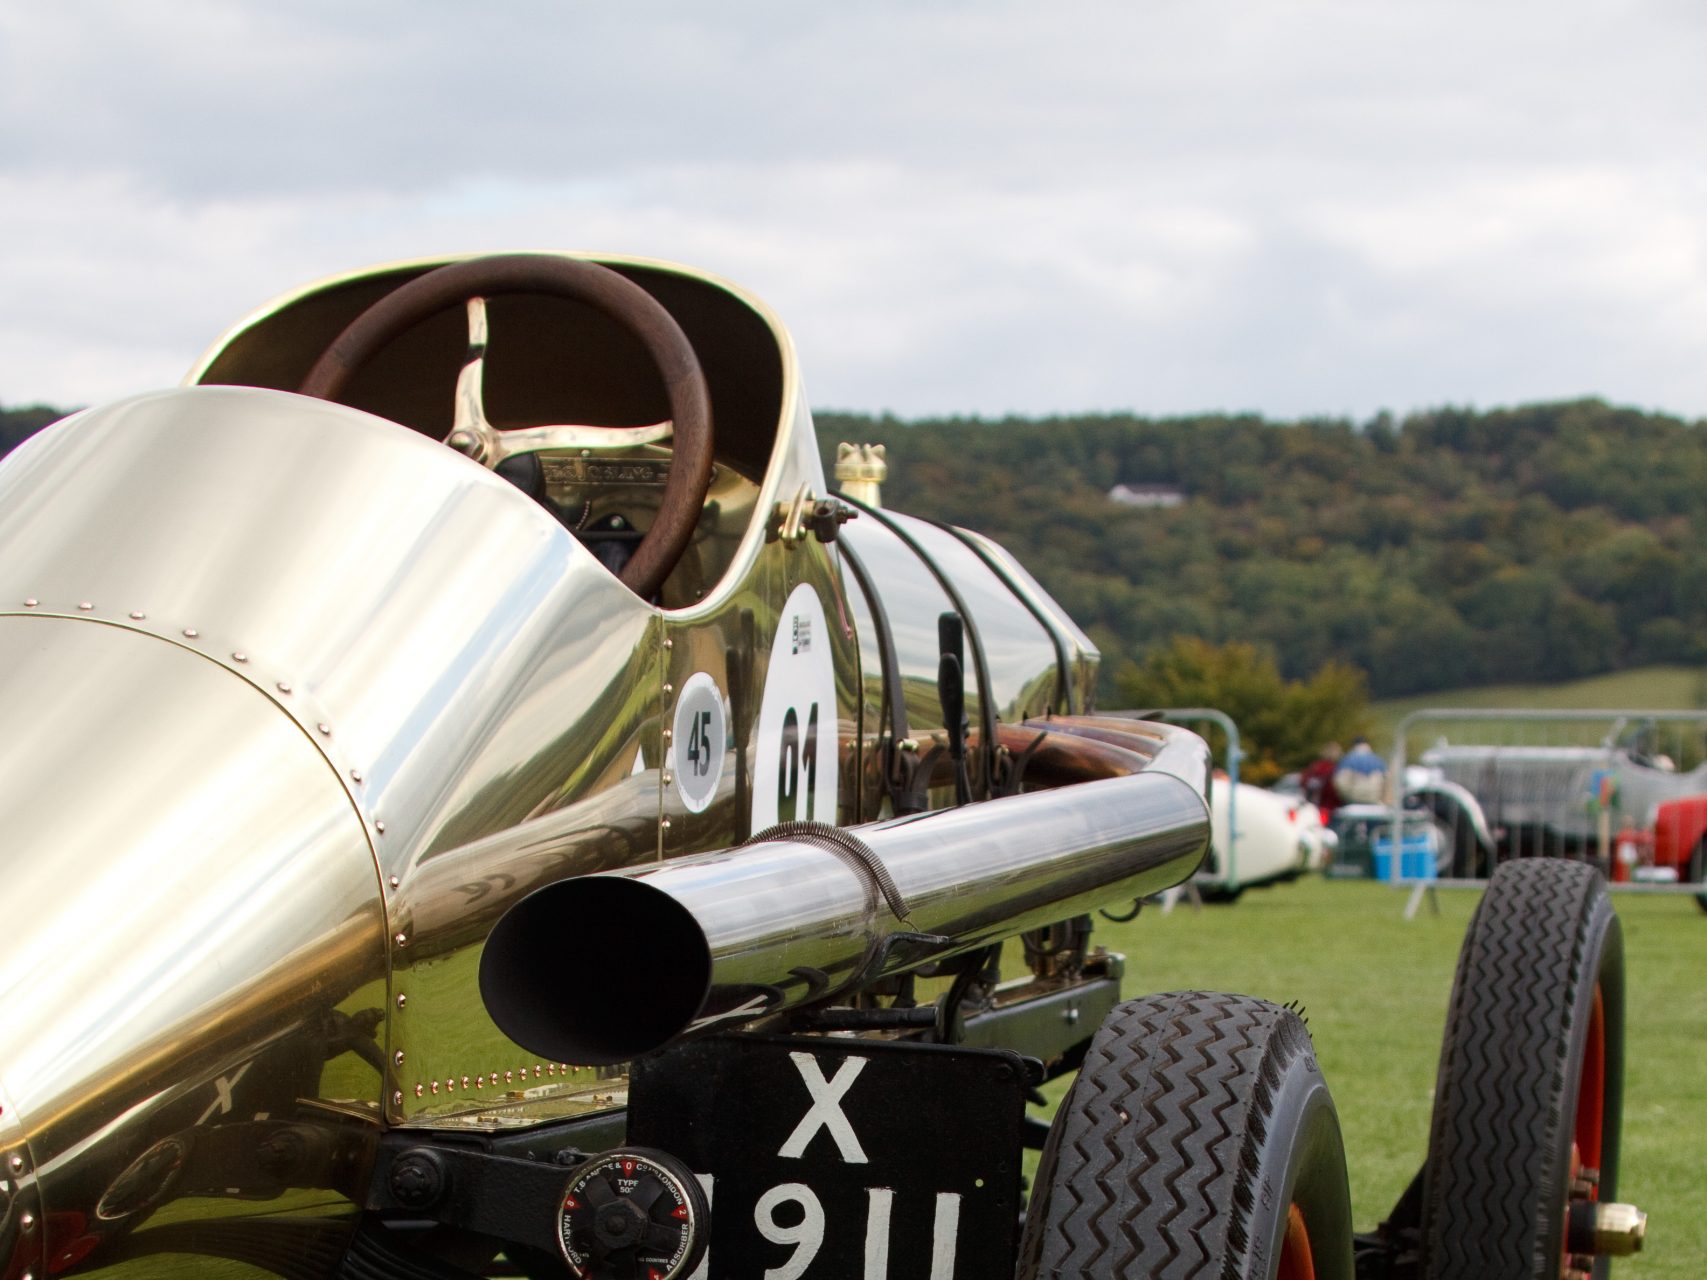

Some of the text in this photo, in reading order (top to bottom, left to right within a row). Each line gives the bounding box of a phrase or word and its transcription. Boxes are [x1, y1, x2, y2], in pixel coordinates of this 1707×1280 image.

[687, 711, 711, 777] 45
[777, 701, 819, 822] 01
[777, 1051, 869, 1164] X
[614, 1161, 622, 1169] &
[657, 1172, 684, 1206] LONDON
[625, 1161, 632, 1170] 0
[566, 1199, 575, 1207] 8
[665, 1223, 689, 1271] ABSORBER
